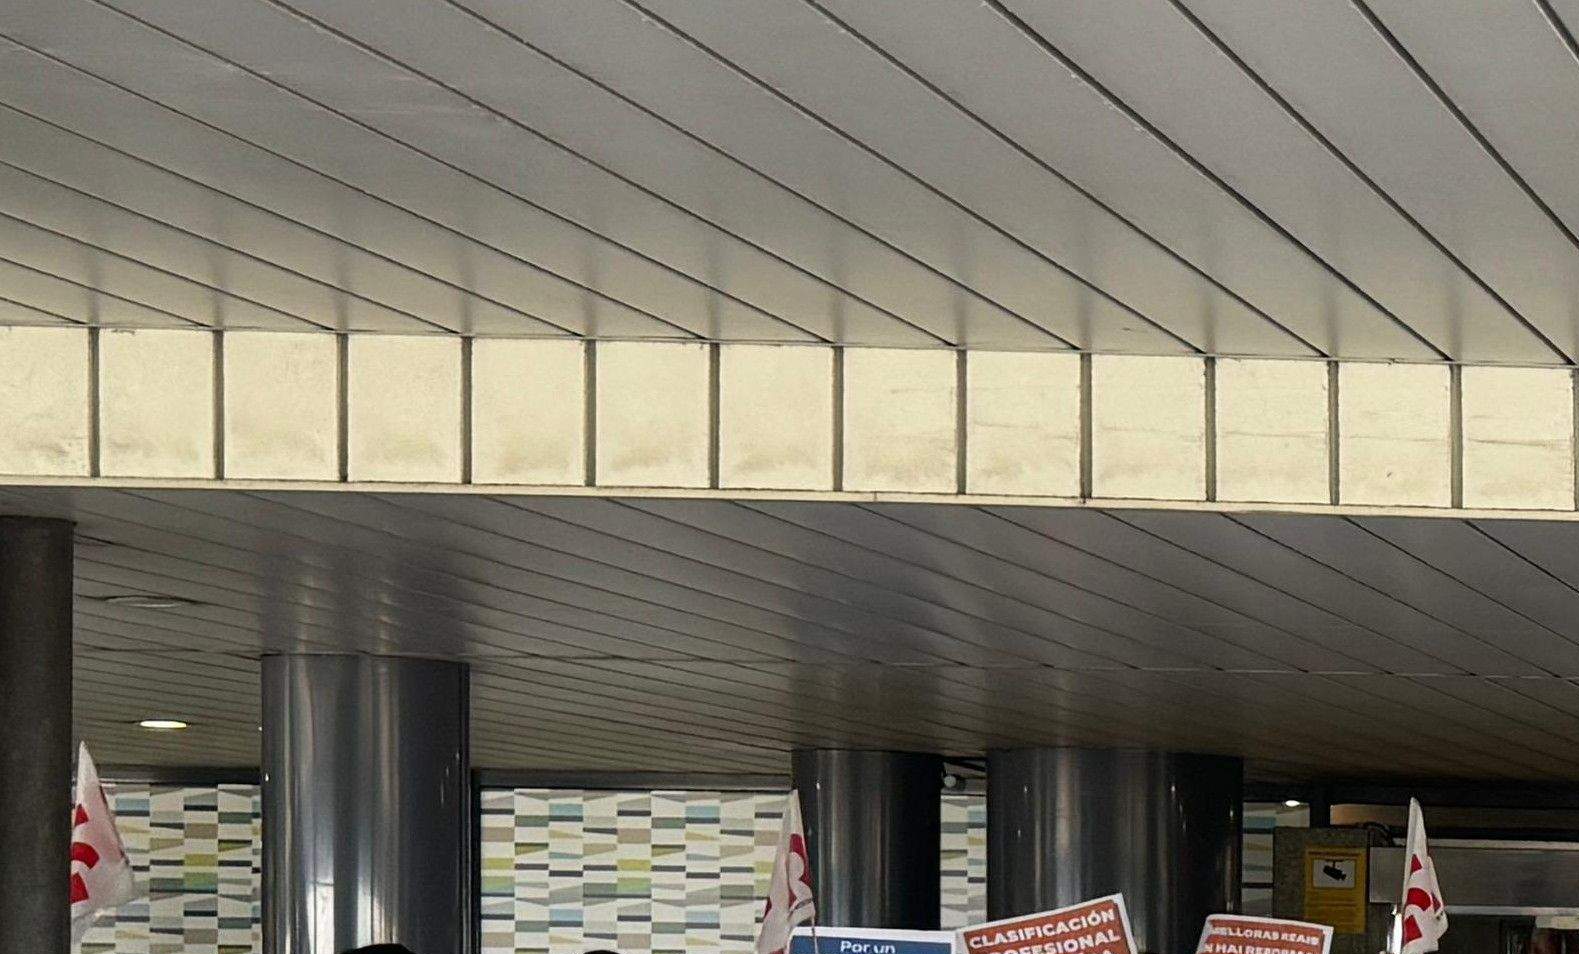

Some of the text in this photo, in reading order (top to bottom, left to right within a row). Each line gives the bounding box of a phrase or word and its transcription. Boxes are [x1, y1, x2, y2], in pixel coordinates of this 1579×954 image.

[970, 909, 1115, 949] CLASIFICACIÓN
[840, 940, 896, 954] Por un
[1216, 944, 1242, 954] HAI
